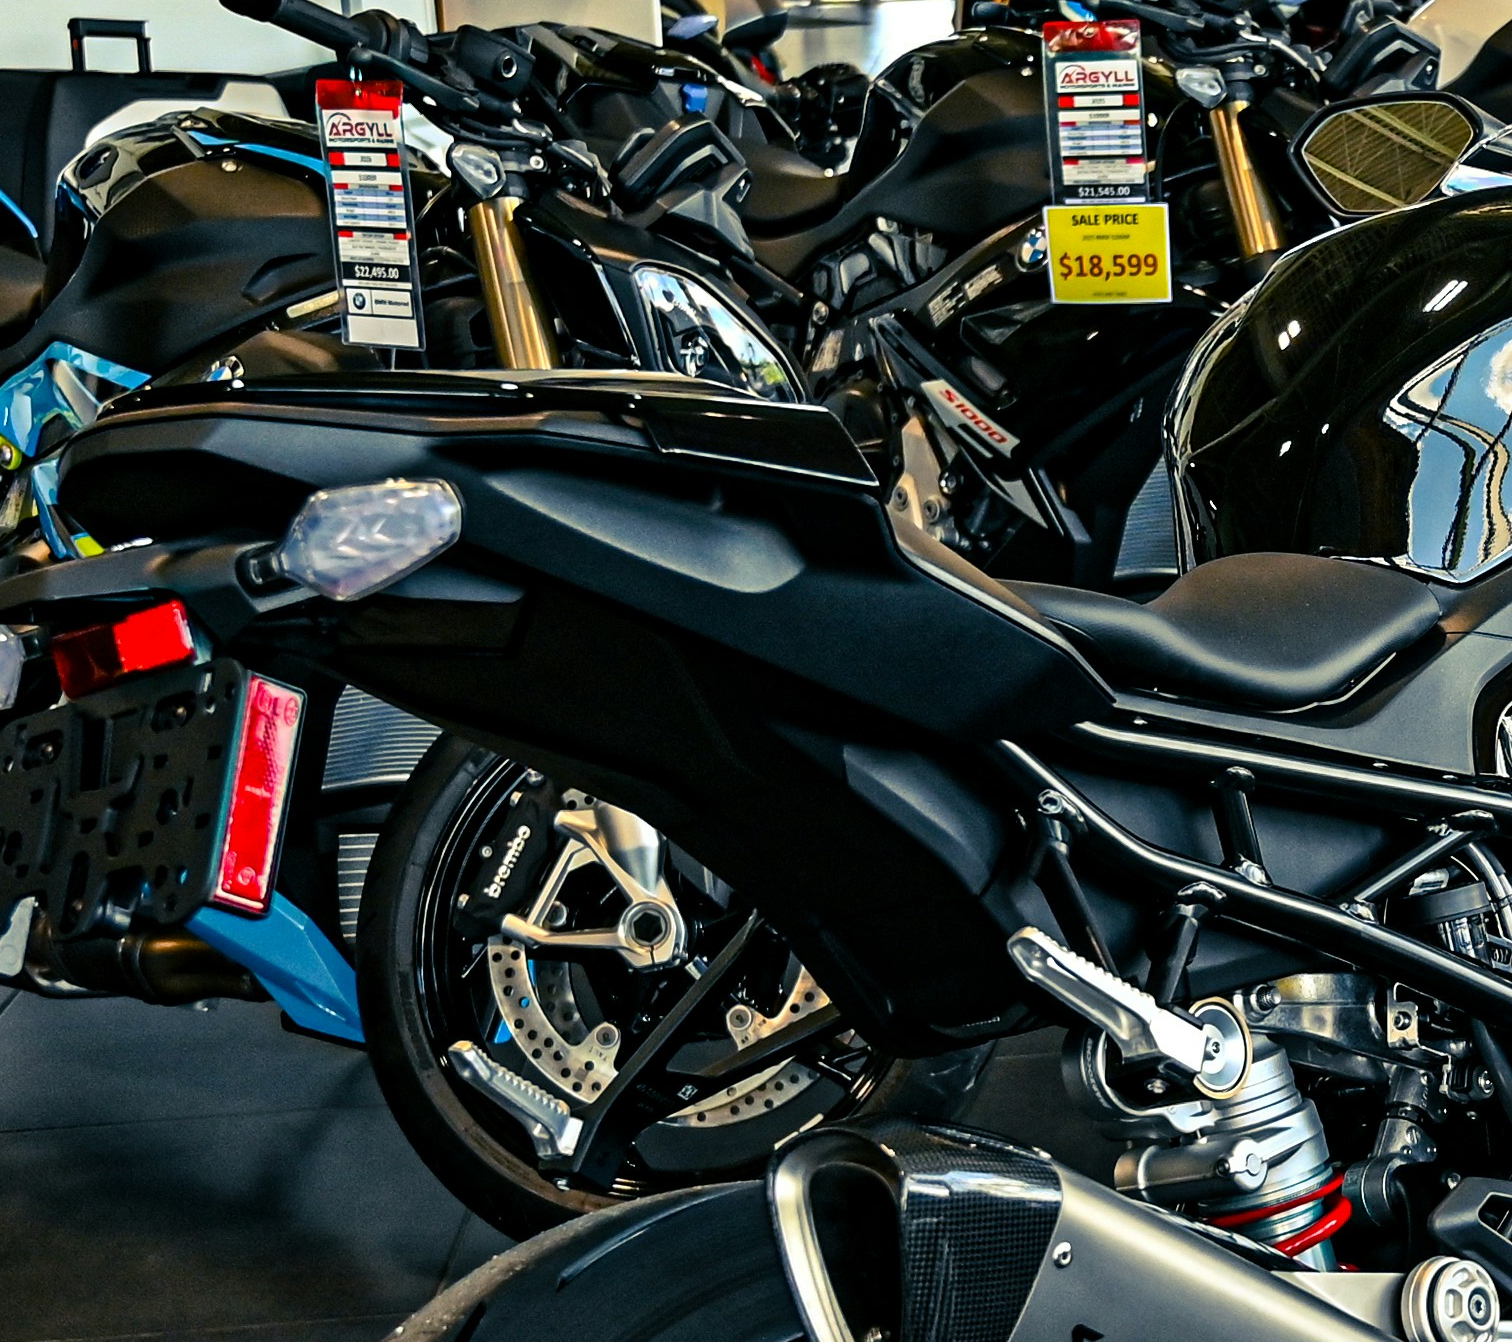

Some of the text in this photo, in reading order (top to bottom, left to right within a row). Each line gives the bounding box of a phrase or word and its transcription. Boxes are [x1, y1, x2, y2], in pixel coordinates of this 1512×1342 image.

[1060, 67, 1135, 85] ARGYLL
[329, 120, 394, 138] ARGYLL
[1071, 213, 1139, 226] SALE PRICE
[354, 265, 400, 281] $22,495.00
[1059, 252, 1159, 281] $18,599
[939, 387, 1009, 446] S1000
[483, 824, 532, 899] brembo
